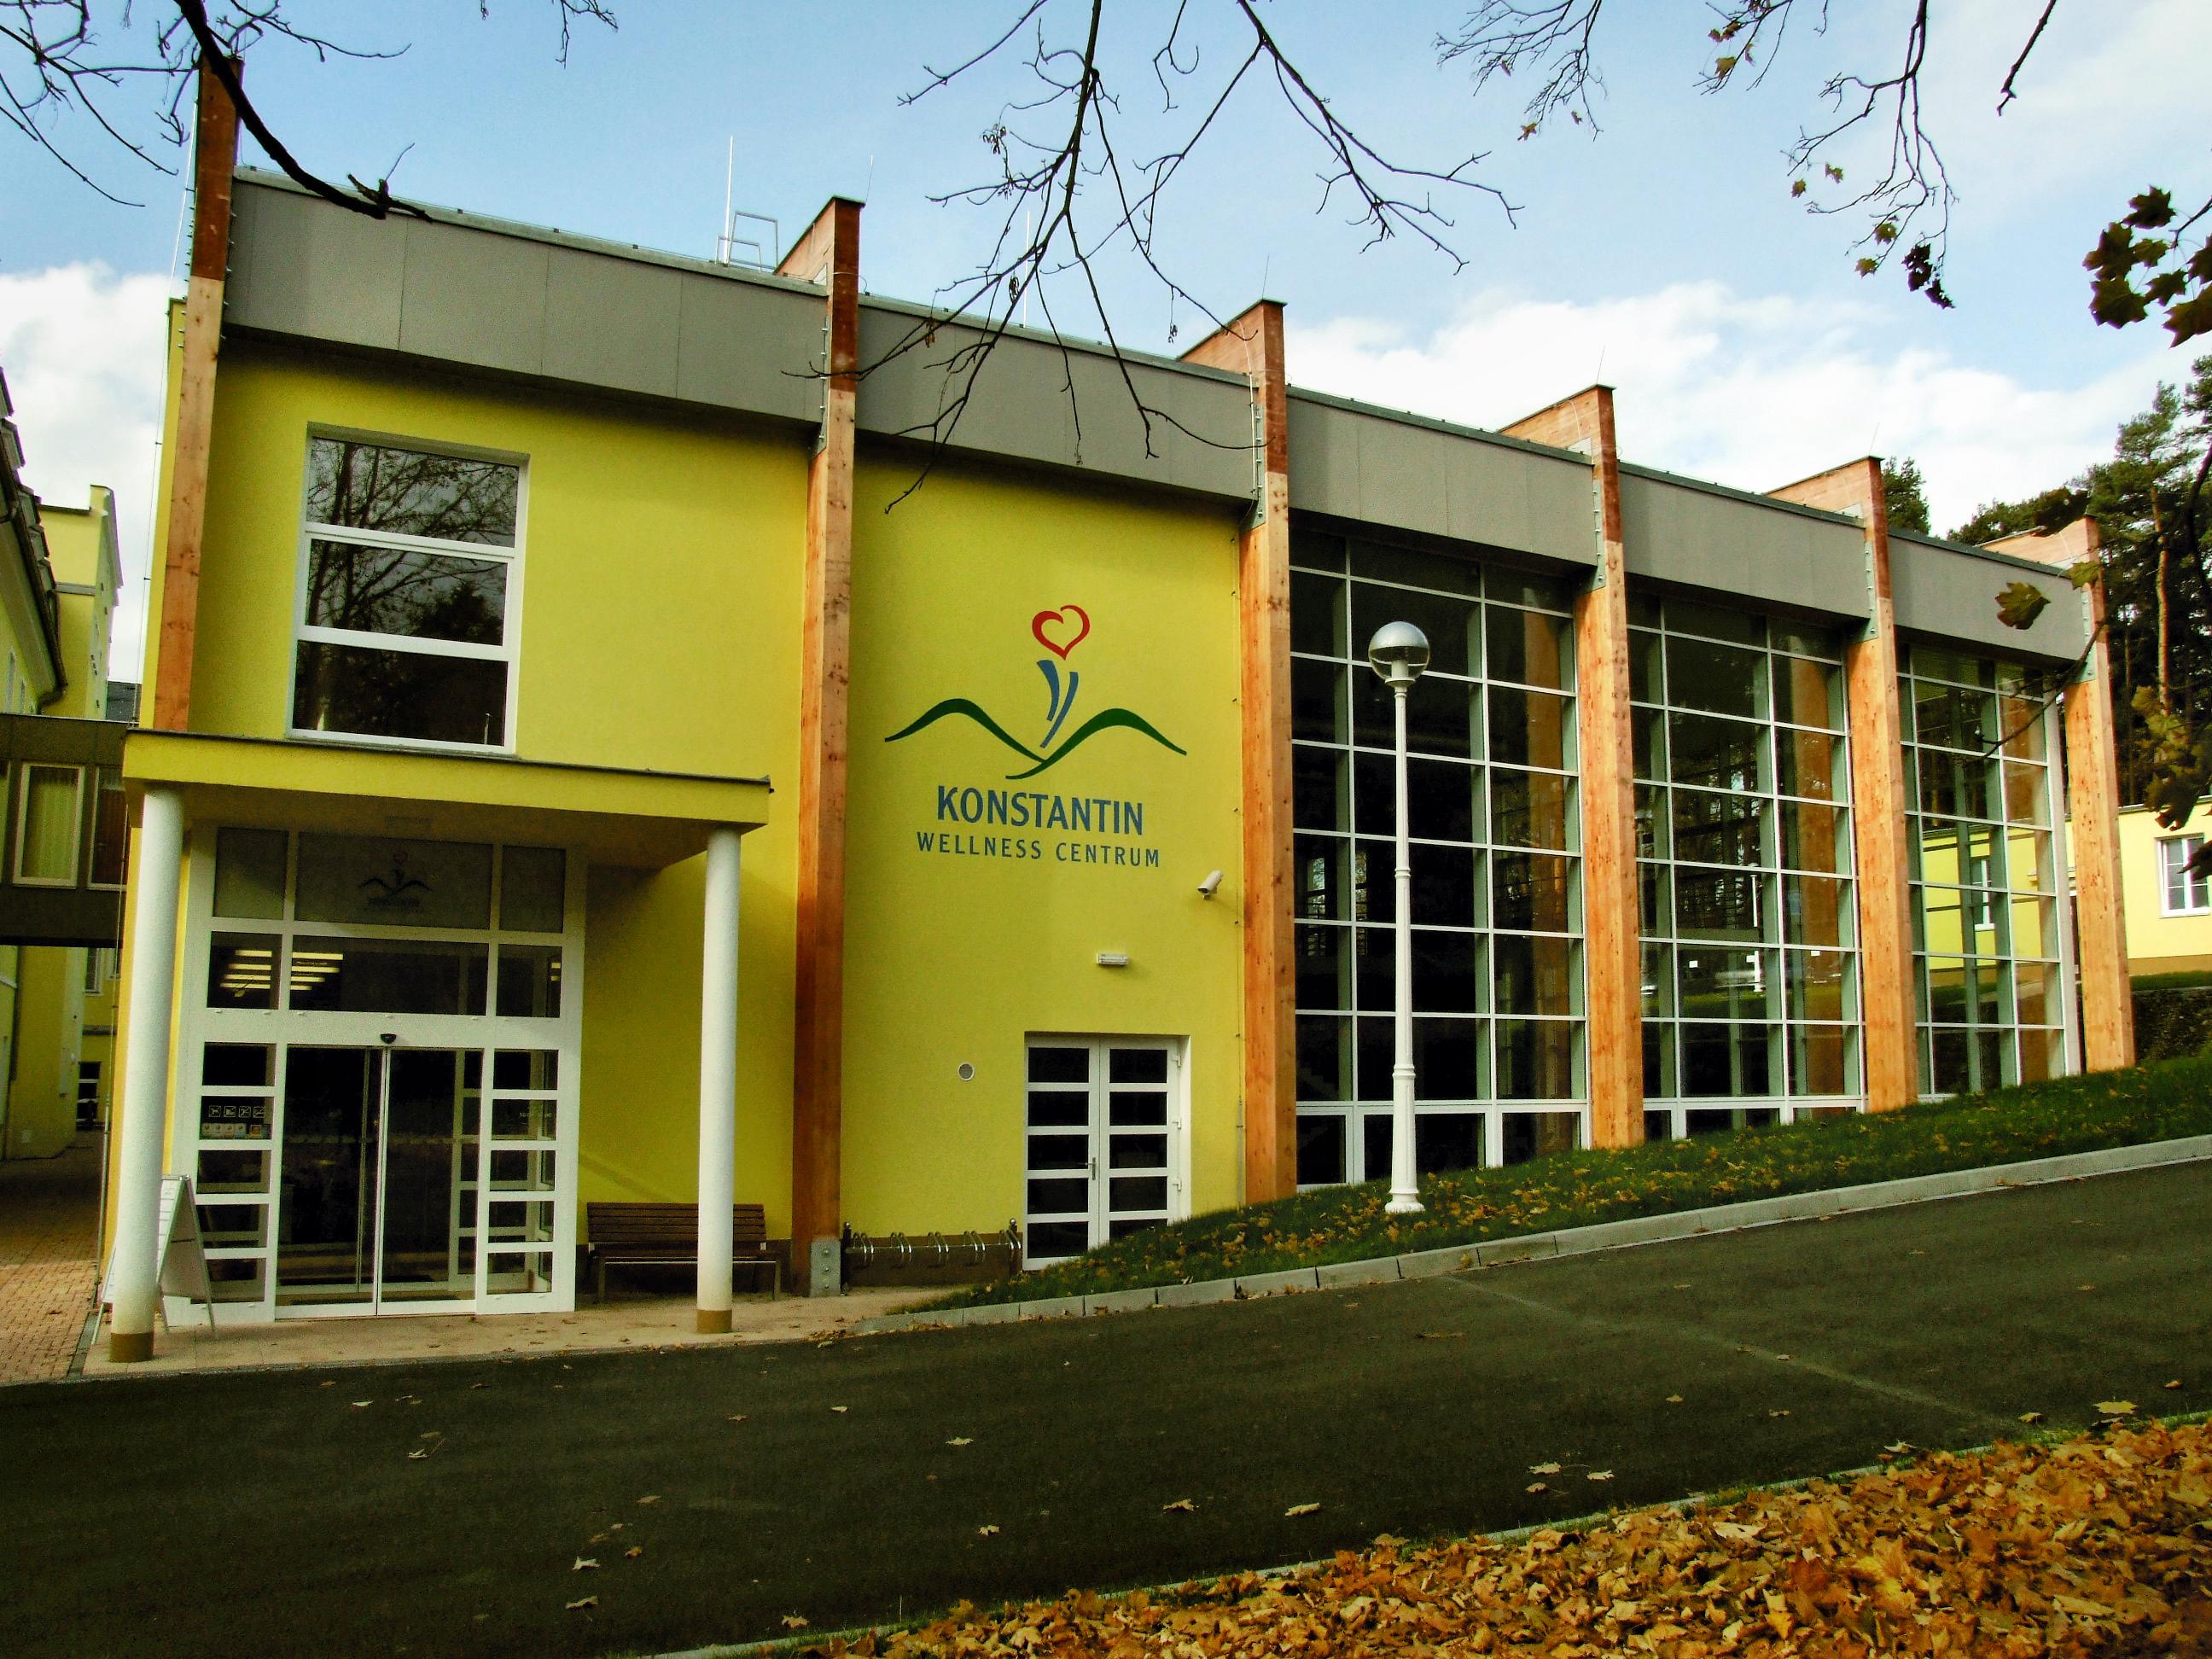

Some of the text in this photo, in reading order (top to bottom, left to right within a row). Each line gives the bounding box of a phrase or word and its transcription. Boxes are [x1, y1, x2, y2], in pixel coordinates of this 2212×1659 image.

[938, 785, 1143, 835] KONSTANTIN
[917, 830, 1160, 868] WELLNESS CENTRUM
